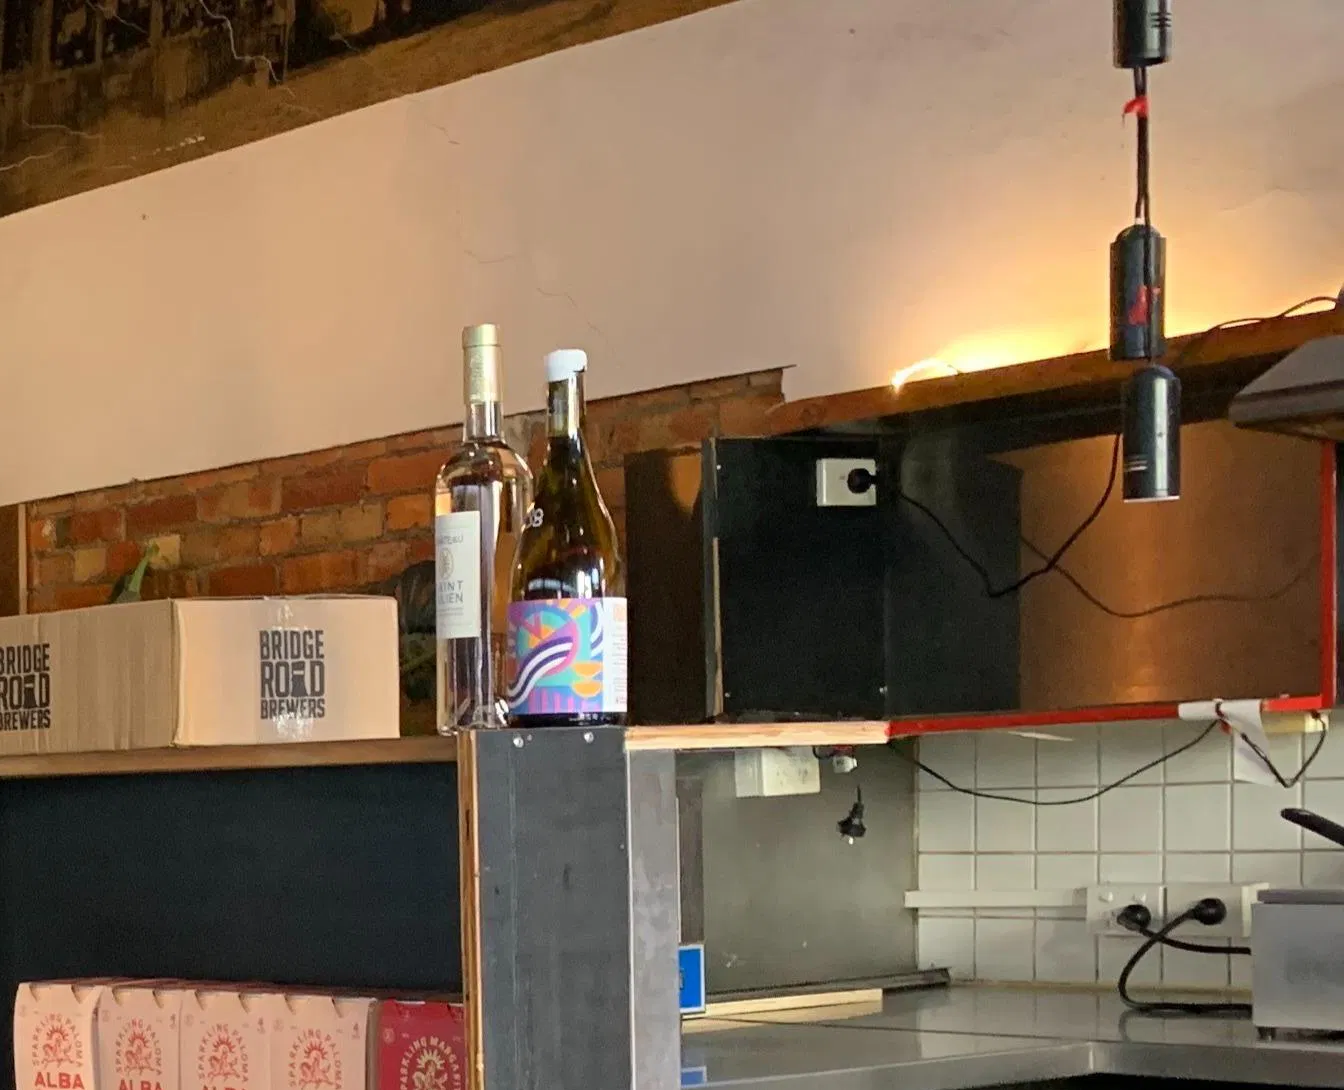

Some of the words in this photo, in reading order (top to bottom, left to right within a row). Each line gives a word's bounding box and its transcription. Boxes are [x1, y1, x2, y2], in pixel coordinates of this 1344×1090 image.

[259, 629, 324, 659] BRIDGE
[260, 697, 325, 720] BREWERS
[34, 1072, 85, 1090] ALBA
